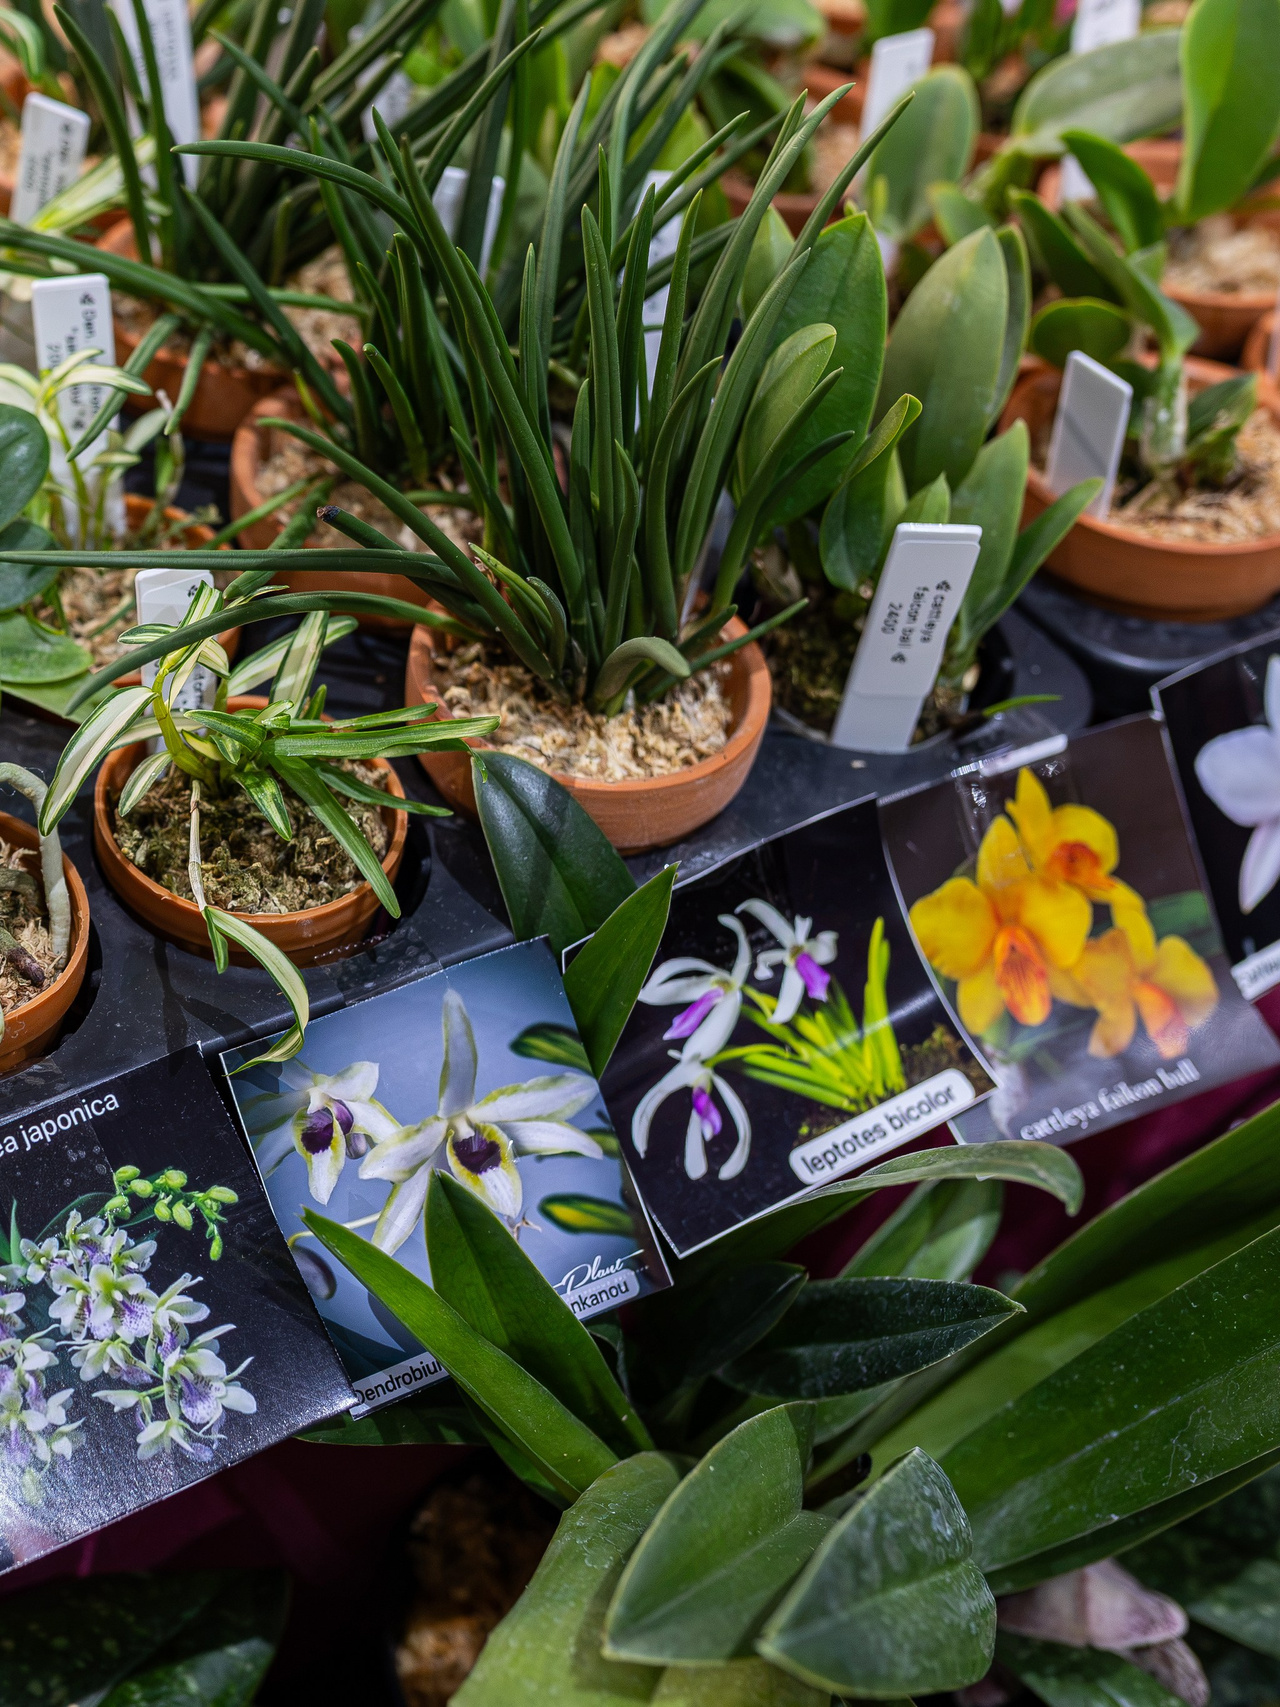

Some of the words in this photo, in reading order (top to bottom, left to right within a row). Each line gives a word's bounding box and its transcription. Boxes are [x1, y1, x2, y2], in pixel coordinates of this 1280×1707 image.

[1155, 1058, 1201, 1090] ball
[20, 1093, 120, 1151] japonica
[801, 1122, 887, 1175] leptotes
[885, 1085, 956, 1130] bicolor
[570, 1279, 630, 1314] nkanou
